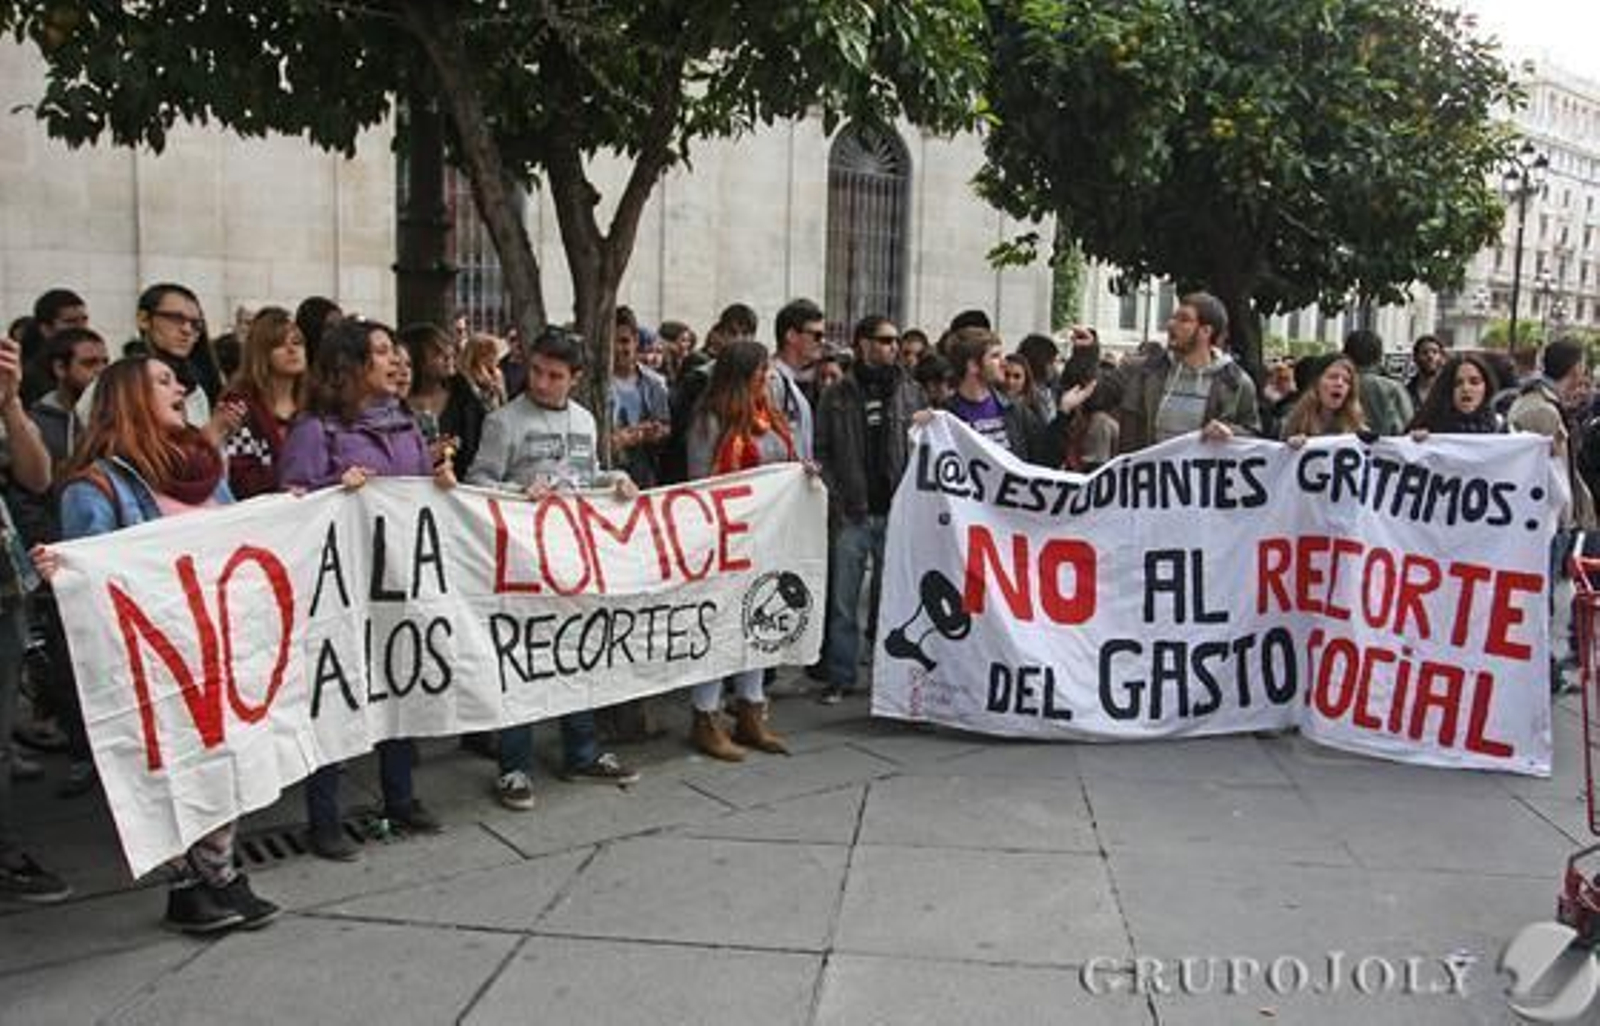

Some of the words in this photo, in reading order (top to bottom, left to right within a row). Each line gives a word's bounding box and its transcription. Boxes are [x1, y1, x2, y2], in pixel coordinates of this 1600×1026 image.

[107, 544, 295, 772] NO
[309, 520, 350, 617] A
[368, 506, 447, 602] LA
[486, 484, 754, 597] LOMCE
[961, 524, 1098, 625] NO
[1143, 547, 1230, 625] AL
[1257, 534, 1545, 661] RECORTE
[310, 638, 360, 718] A
[365, 616, 453, 704] LOS
[489, 600, 718, 693] RECORTES
[986, 662, 1072, 720] DEL
[1099, 626, 1298, 721] GASTO
